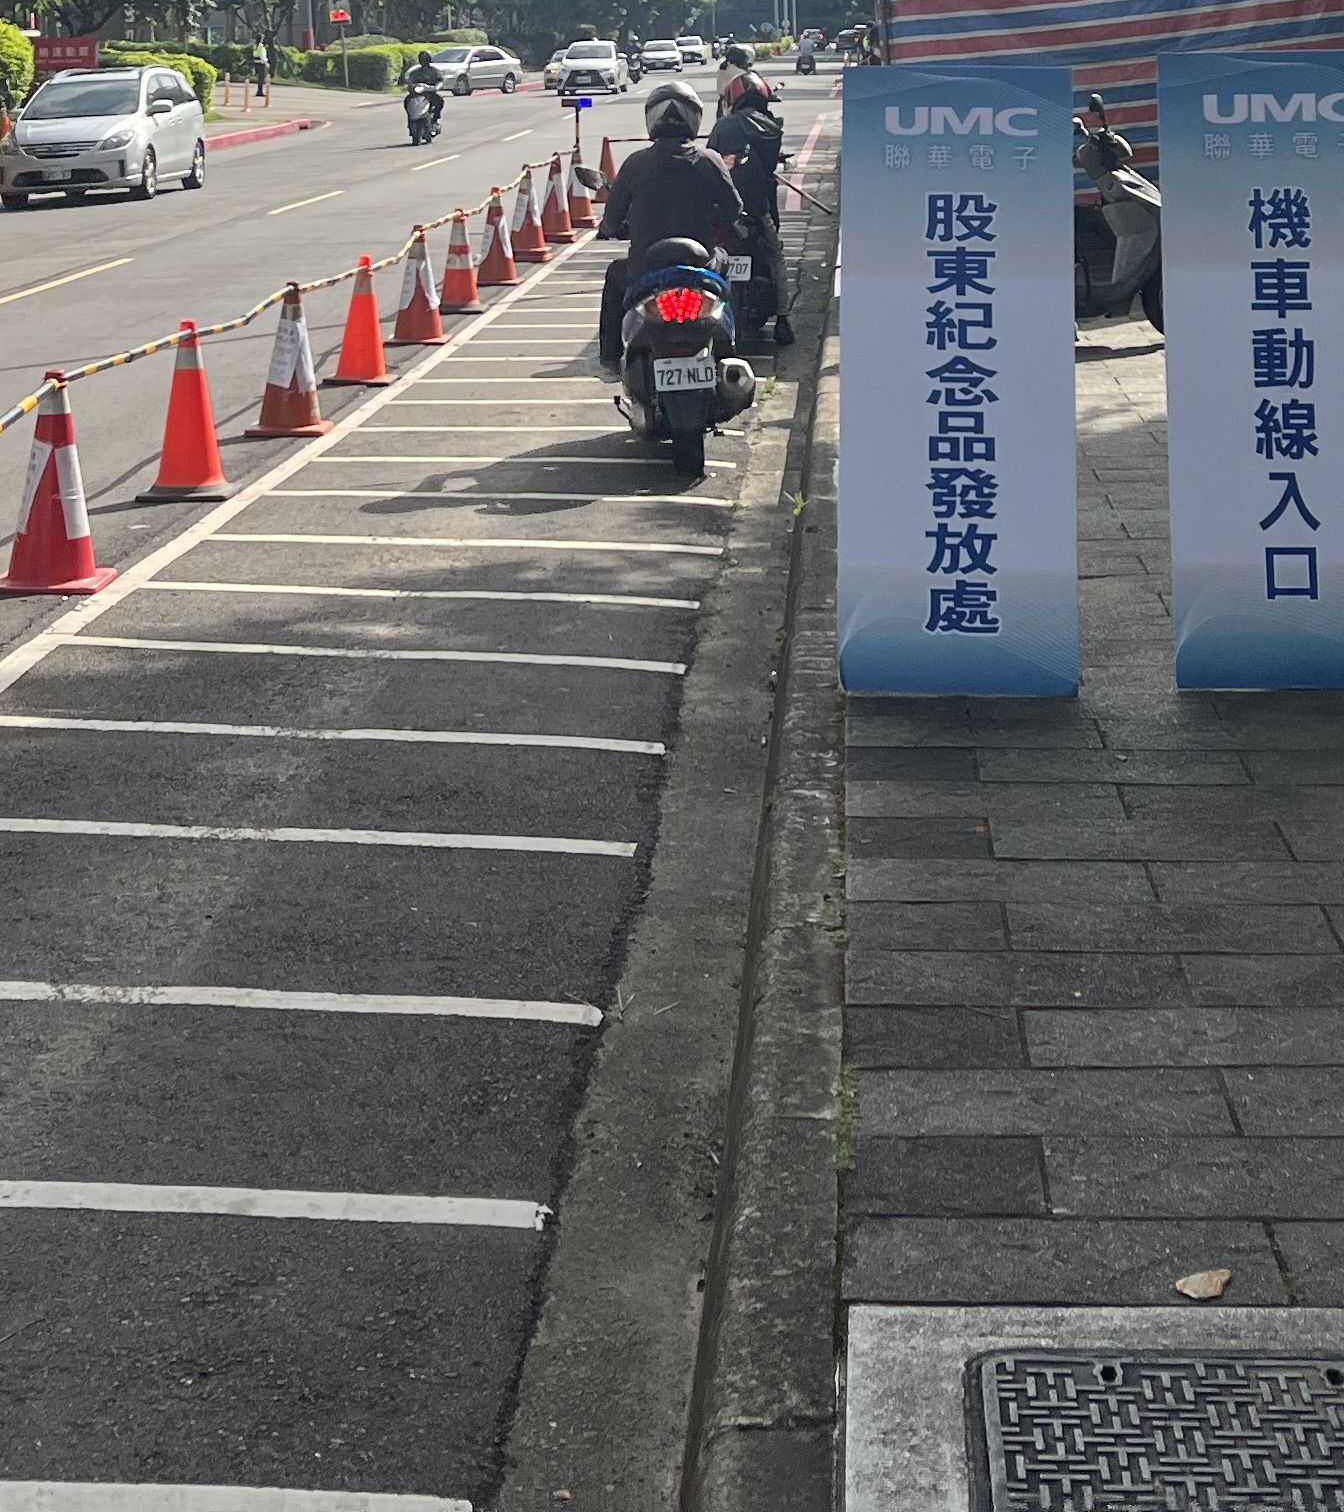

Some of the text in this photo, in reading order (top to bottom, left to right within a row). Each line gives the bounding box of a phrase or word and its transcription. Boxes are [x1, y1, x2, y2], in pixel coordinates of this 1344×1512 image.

[884, 106, 1039, 137] UMC
[884, 144, 1040, 171] 聯華電子
[925, 193, 1000, 635] 股東紀念品發放處
[1247, 187, 1321, 600] 機車動線入口
